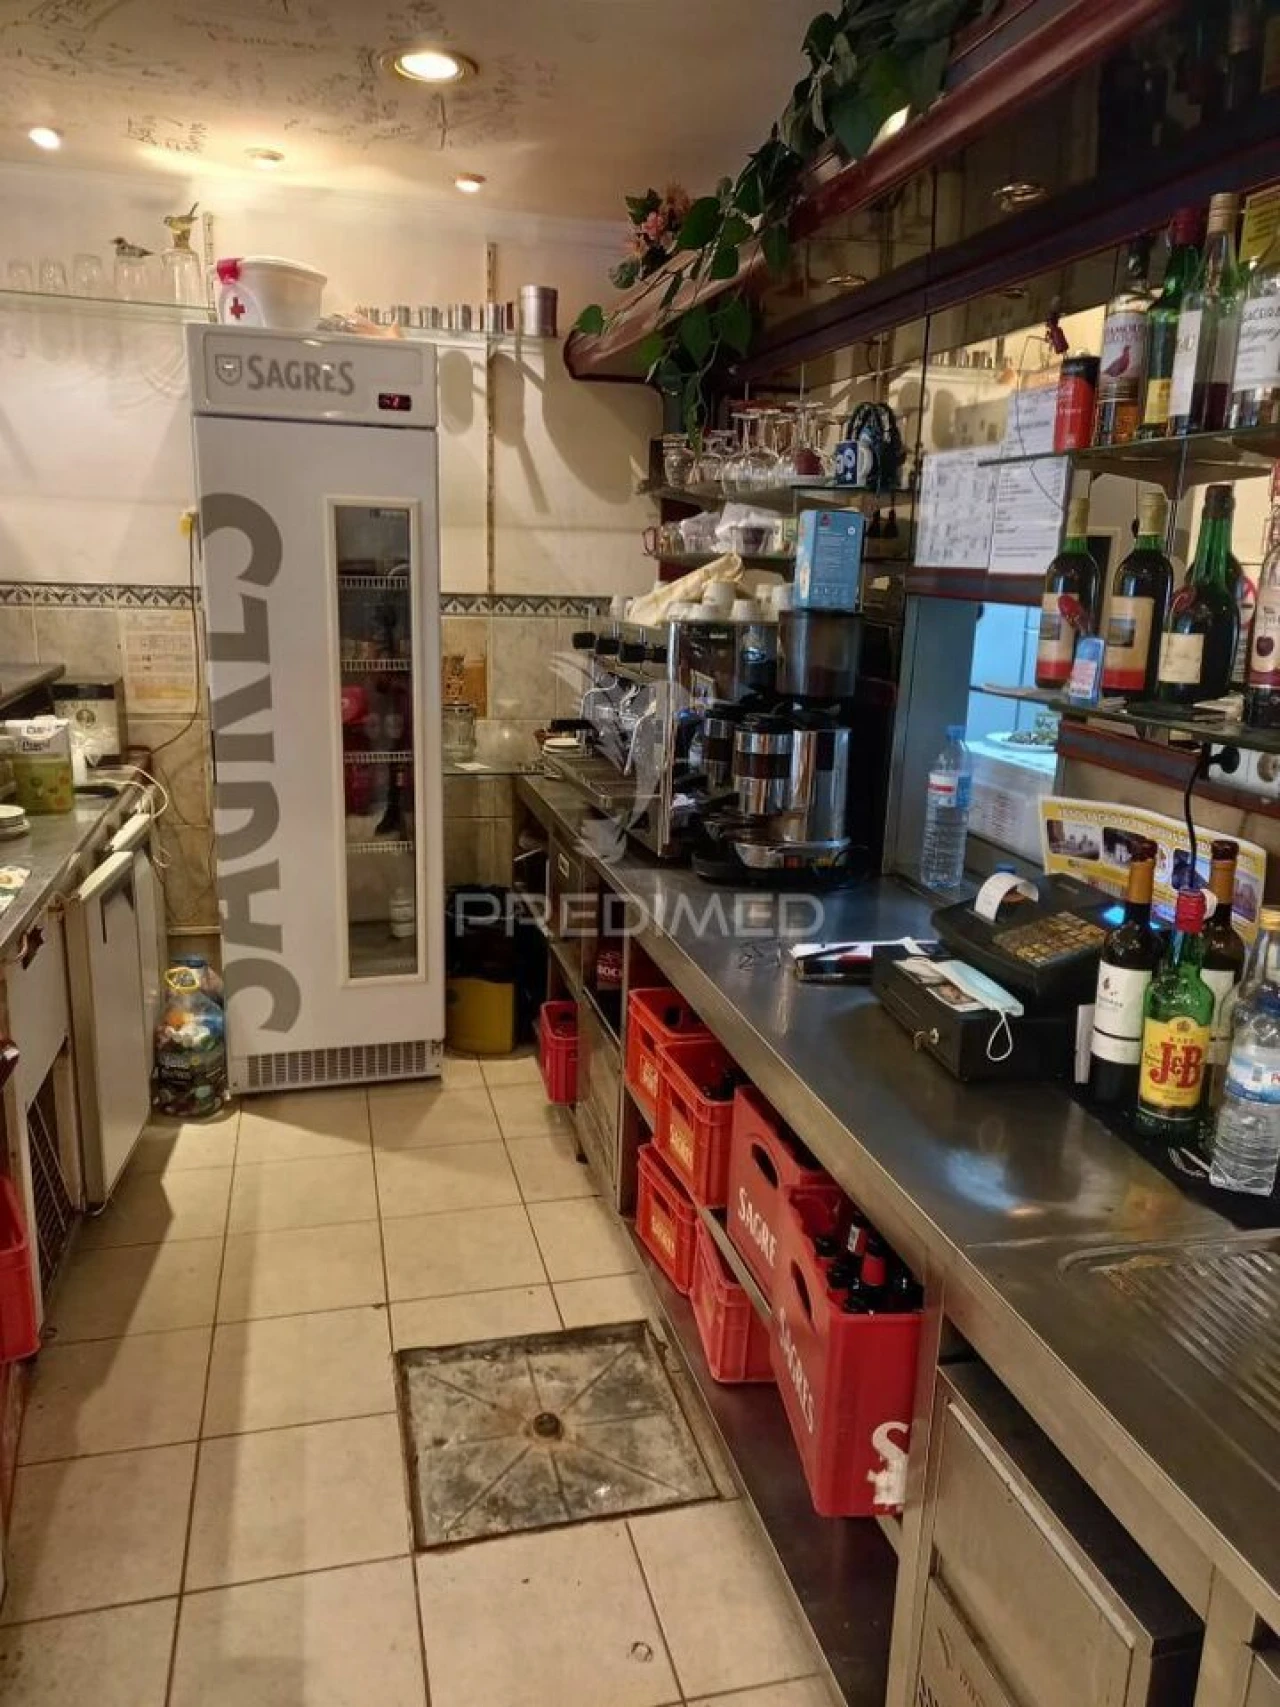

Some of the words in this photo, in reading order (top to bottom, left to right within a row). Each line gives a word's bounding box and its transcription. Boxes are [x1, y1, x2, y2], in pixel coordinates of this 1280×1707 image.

[248, 354, 355, 396] SAGRES
[1149, 1042, 1203, 1089] J&B
[737, 1186, 778, 1267] SAGRE
